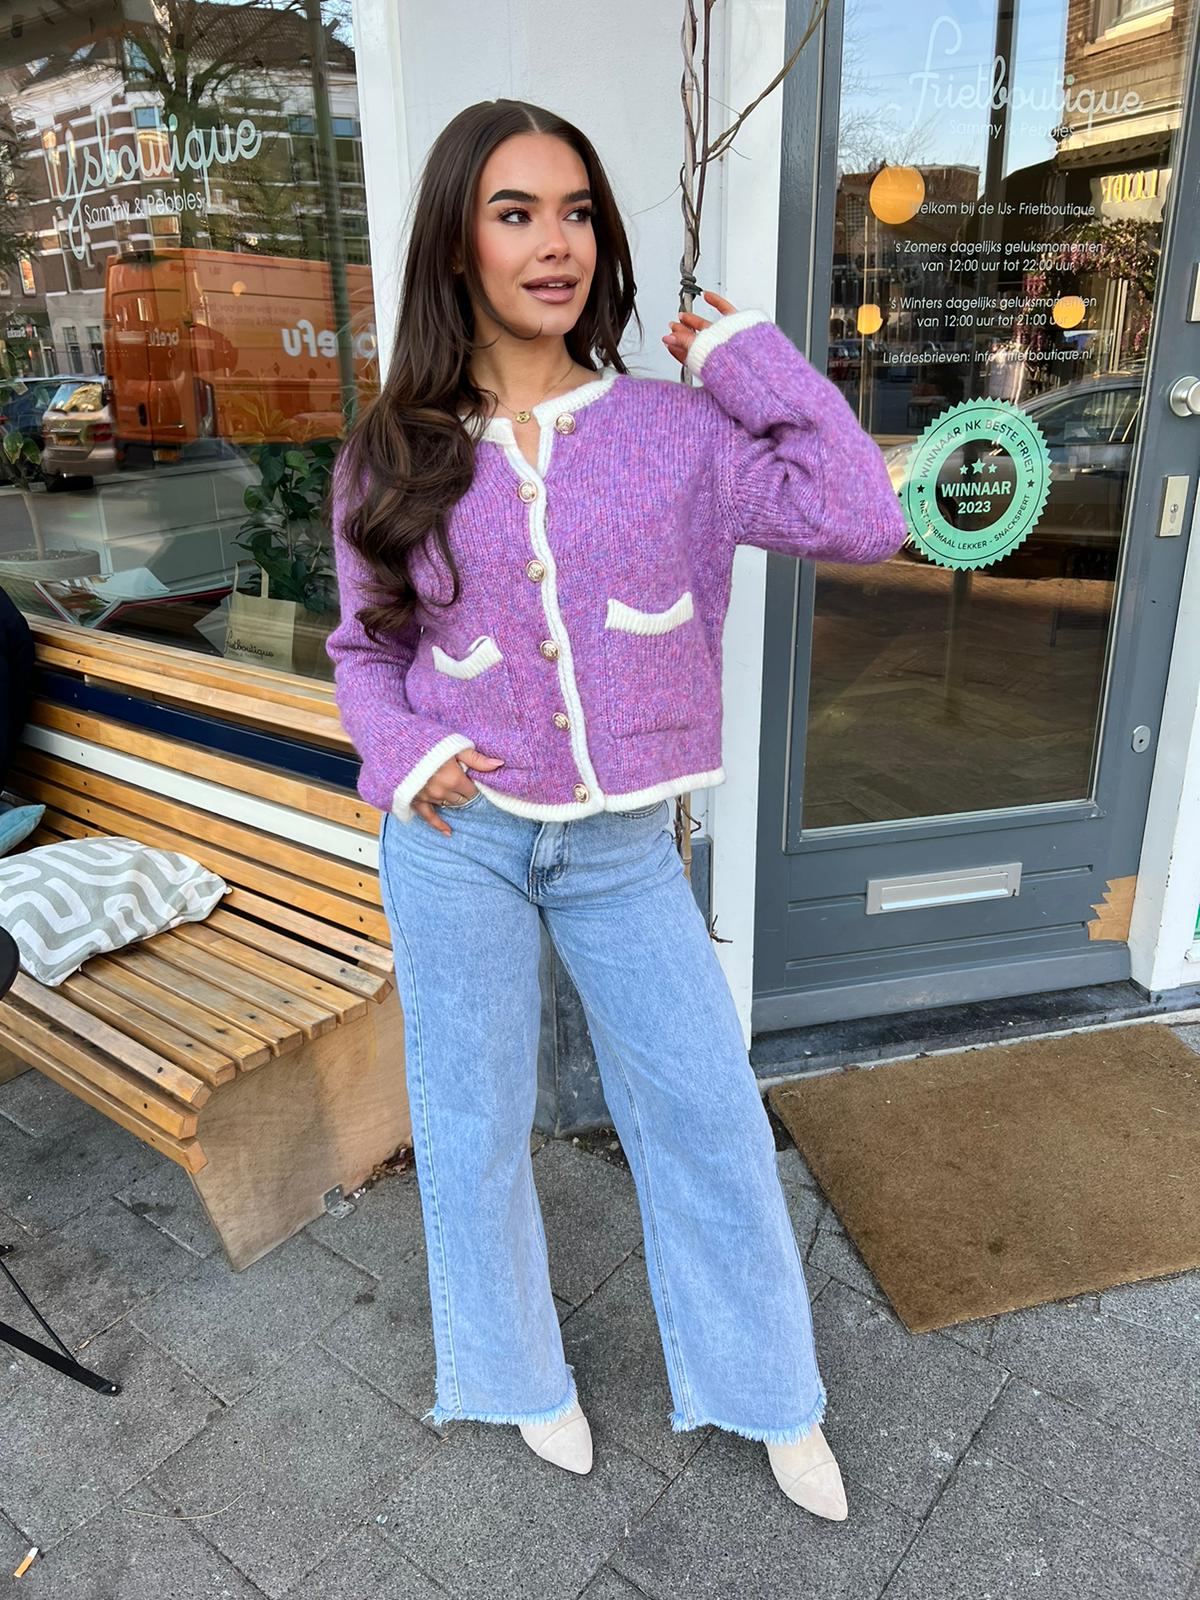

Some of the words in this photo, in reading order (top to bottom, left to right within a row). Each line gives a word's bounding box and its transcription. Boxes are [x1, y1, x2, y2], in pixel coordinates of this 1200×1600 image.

[950, 119, 1002, 138] Sammy
[84, 204, 130, 225] Sammy
[134, 197, 146, 217] &
[146, 188, 202, 216] Pebbles
[912, 202, 957, 215] elkom
[961, 202, 976, 217] bij
[978, 202, 994, 215] de
[1019, 202, 1096, 218] Frietboutique
[904, 240, 947, 253] Zomers
[950, 240, 1002, 256] dagelijks
[1005, 240, 1103, 256] geluksmomenten
[921, 262, 944, 272] van
[949, 259, 979, 272] 12:00
[981, 261, 1000, 272] uur
[1003, 259, 1020, 272] tot
[1022, 259, 1053, 272] 22:00
[1055, 260, 1074, 272] uur
[900, 297, 943, 310] Winters
[945, 296, 997, 312] dagelijks
[1000, 296, 1097, 311] geluksmoten
[917, 317, 940, 328] van
[944, 315, 973, 328] 12:00
[976, 317, 996, 327] uur
[998, 314, 1015, 327] tot
[1017, 314, 1047, 326] 21:00
[883, 351, 970, 364] Liefdesbrieven:
[974, 349, 1092, 363] infofrietboutique.nl
[920, 426, 962, 479] WINNAAR
[965, 419, 982, 432] NK
[985, 419, 1019, 442] BESTE
[1016, 440, 1034, 474] FRIET
[941, 481, 1012, 498] WINNAAR
[957, 501, 992, 515] 2023
[958, 541, 988, 550] LEKKER
[994, 495, 1030, 542] SNACKSPERT
